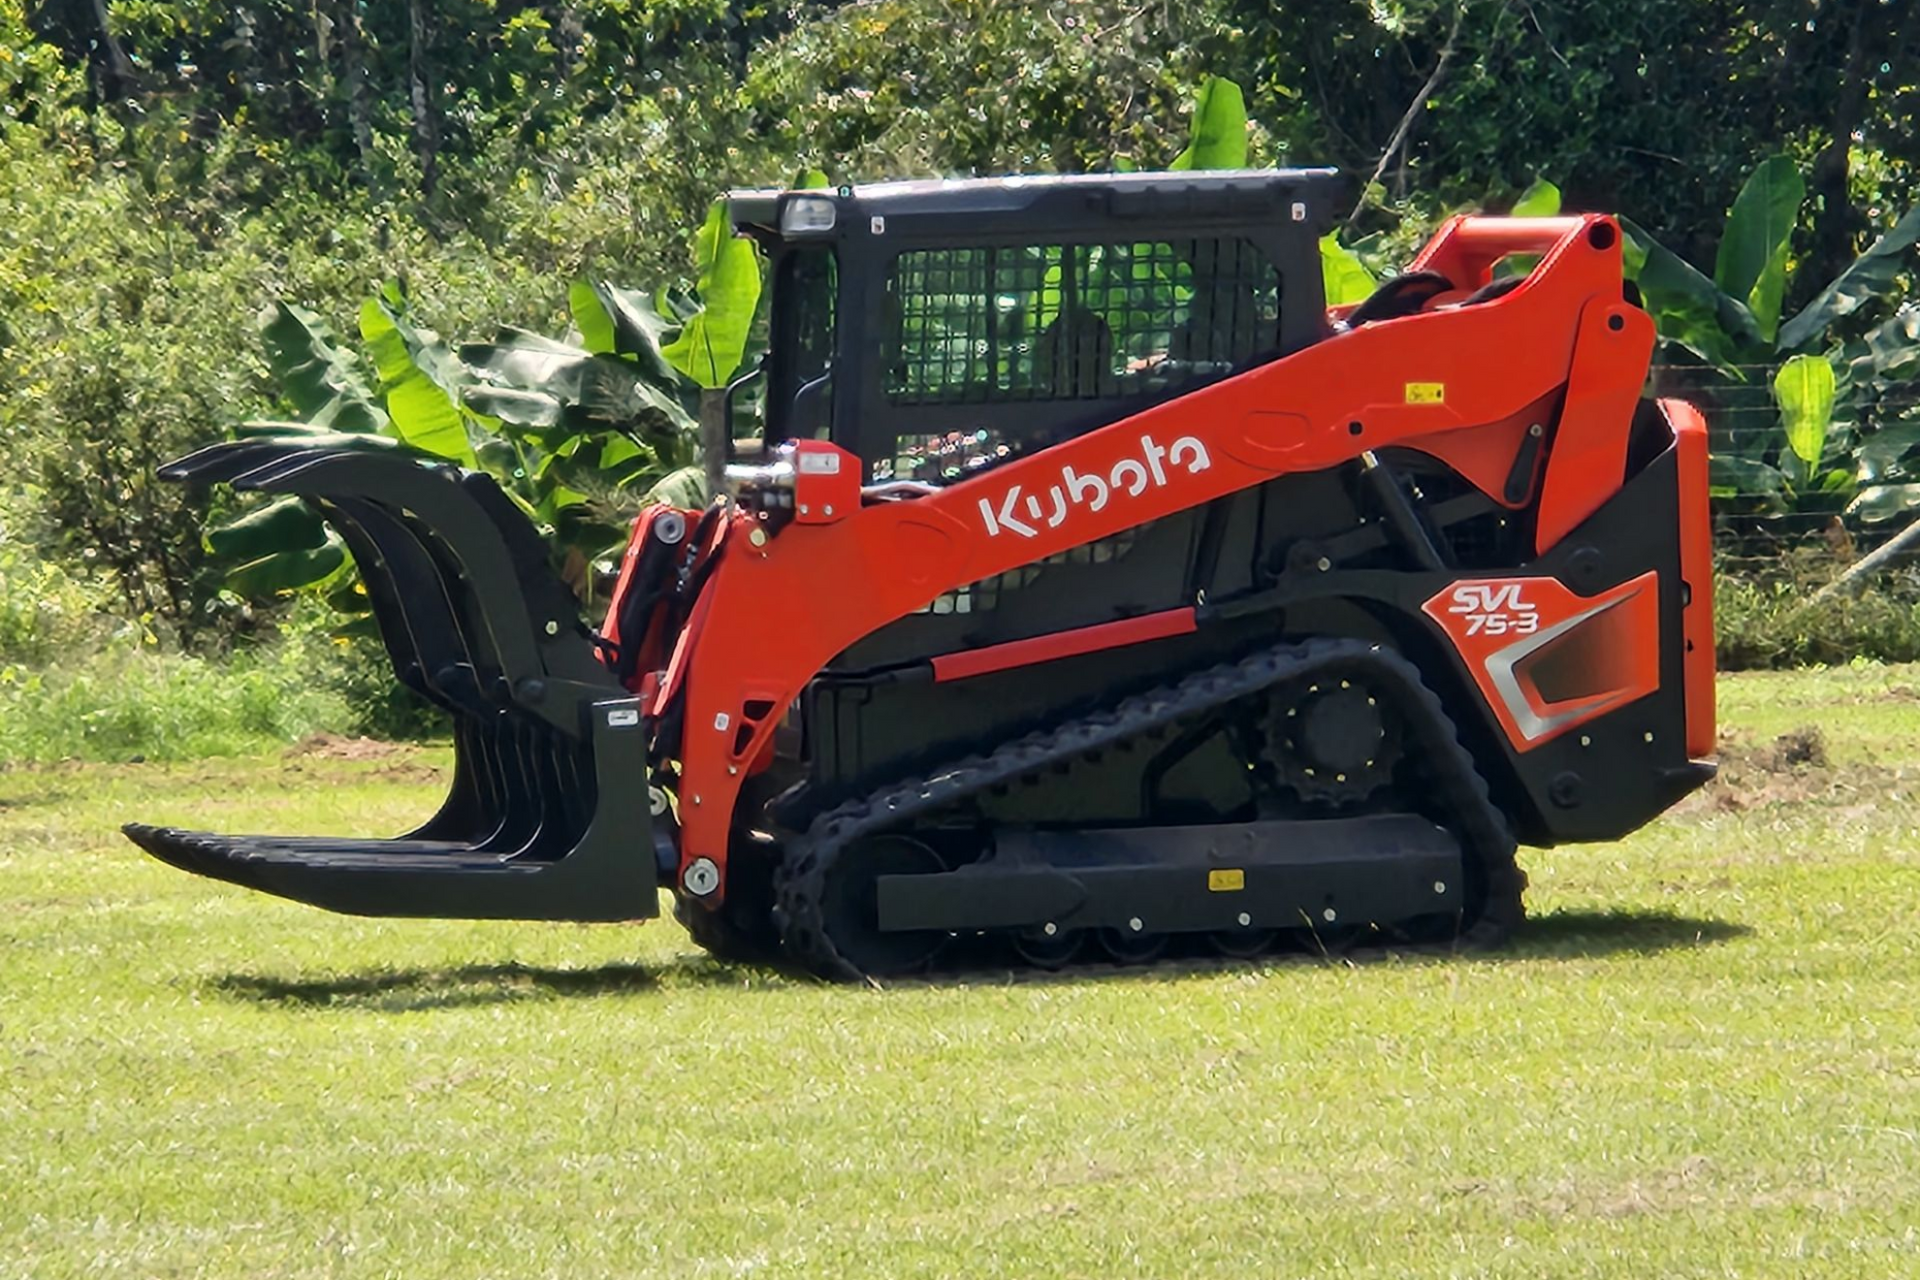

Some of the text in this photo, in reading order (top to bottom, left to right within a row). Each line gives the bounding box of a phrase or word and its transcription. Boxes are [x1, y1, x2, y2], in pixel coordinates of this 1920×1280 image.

[978, 434, 1211, 538] Kubota
[1448, 584, 1536, 613] SVL
[1465, 612, 1538, 636] 75-3
